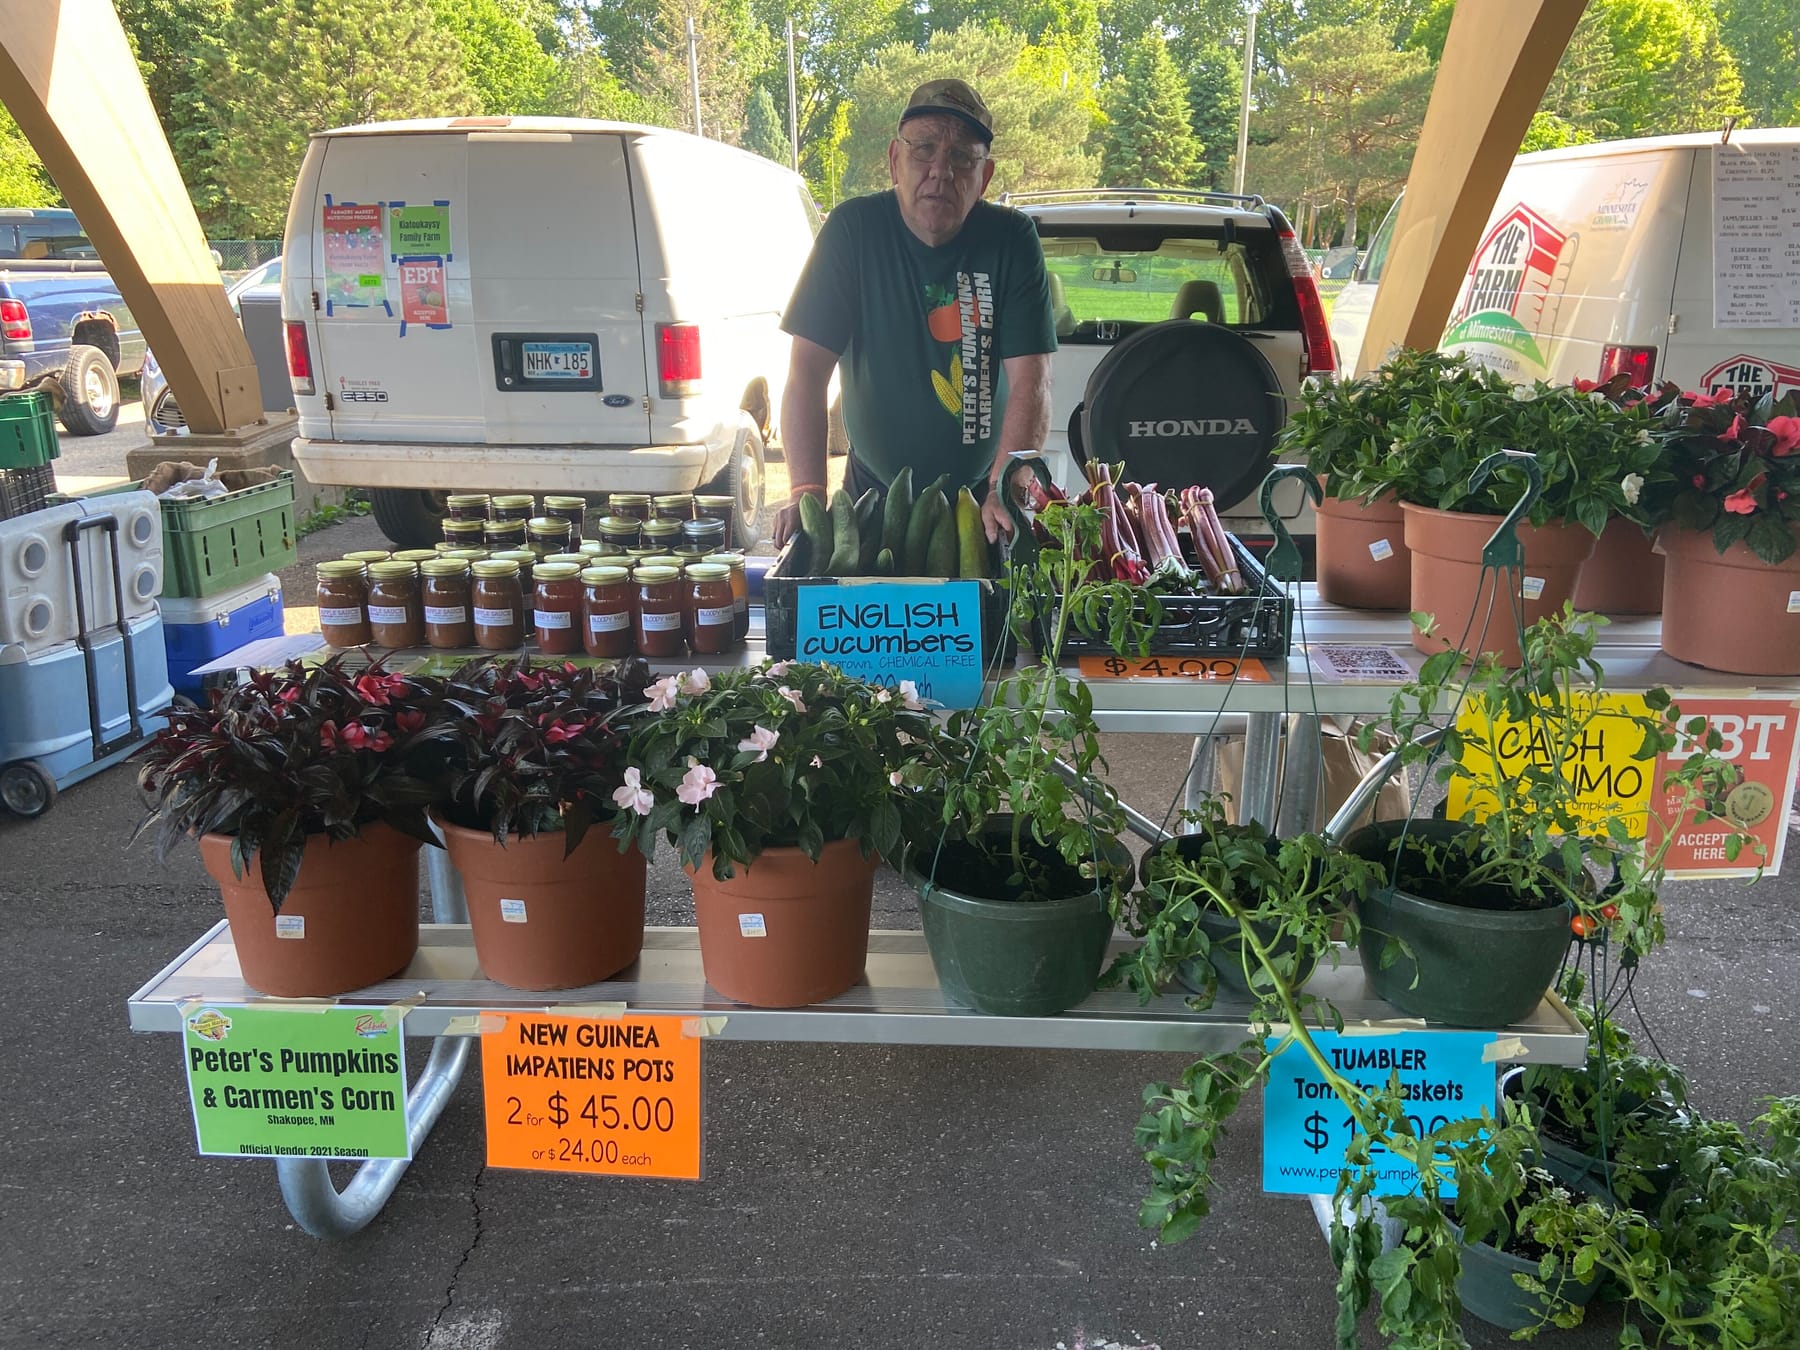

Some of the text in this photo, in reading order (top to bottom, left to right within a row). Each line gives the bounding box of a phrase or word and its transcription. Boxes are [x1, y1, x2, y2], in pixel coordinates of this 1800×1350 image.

[400, 232, 441, 243] Family Farm
[1491, 223, 1526, 265] THE
[404, 267, 439, 284] EBT
[1467, 320, 1515, 344] Minnesota
[527, 353, 588, 370] NHK 185
[956, 271, 977, 445] PETER'S PUMPKINS
[973, 272, 995, 440] CARMEN'S CORN
[1726, 363, 1763, 382] THE
[1128, 418, 1259, 438] HONDA
[817, 602, 960, 630] ENGLISH
[803, 629, 974, 655] cucumbers
[879, 655, 939, 668] CHEMICAL
[944, 654, 976, 667] FREE
[1336, 668, 1409, 676] venmo
[1498, 727, 1604, 762] CASH
[1667, 714, 1786, 760] EBT
[1498, 761, 1642, 798] VMO
[1677, 833, 1745, 846] ACCEPT
[1693, 848, 1727, 860] HERE
[520, 1023, 660, 1048] NEW GUINEA
[190, 1047, 399, 1077] Peter's Pumpkins
[506, 1054, 674, 1082] IMPATIENS POTS
[1331, 1048, 1427, 1071] TUMBLER
[203, 1085, 395, 1111] & Carmen's Corn
[267, 1114, 335, 1126] Shakopee, MN
[506, 1096, 523, 1125] 2
[526, 1113, 544, 1126] for
[239, 1144, 369, 1157] Official Vendor 2021 Season
[531, 1149, 545, 1160] or
[621, 1152, 651, 1166] each
